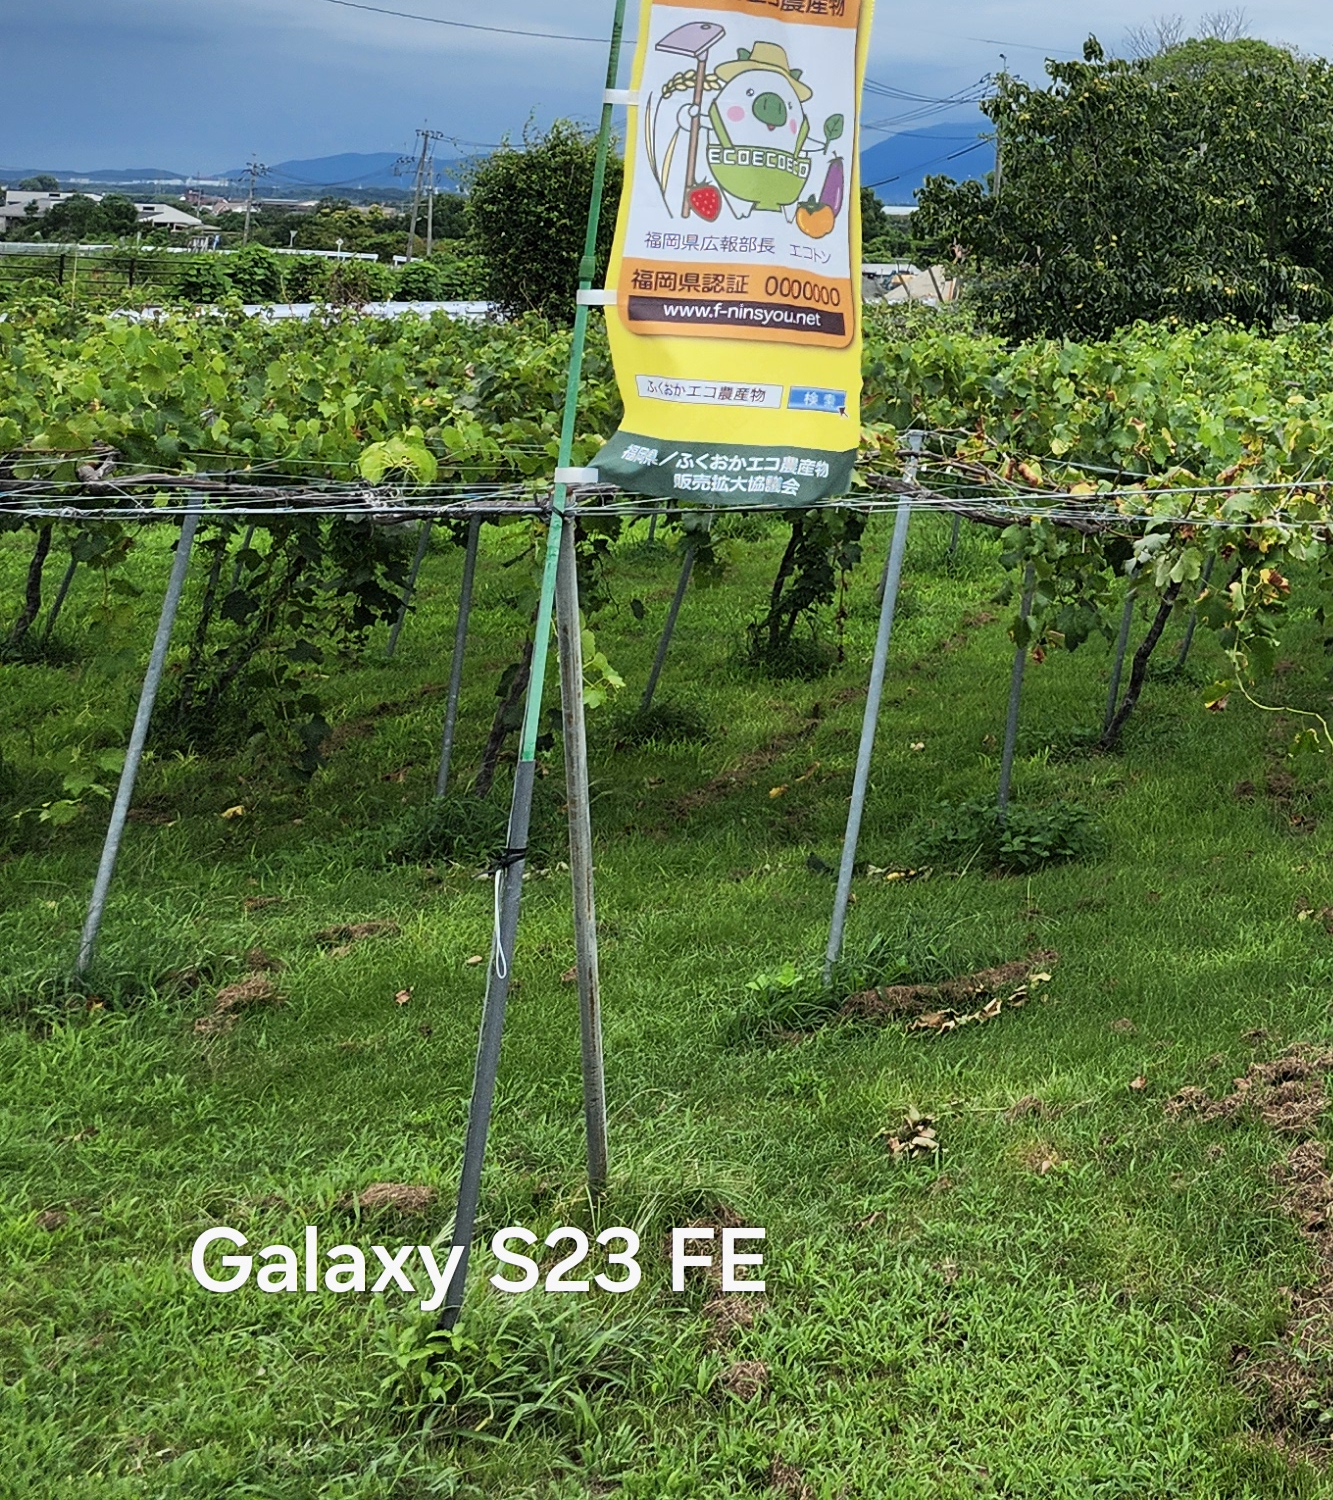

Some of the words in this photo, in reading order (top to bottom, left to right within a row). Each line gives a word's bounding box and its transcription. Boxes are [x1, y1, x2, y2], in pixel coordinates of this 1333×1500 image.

[644, 231, 776, 255] 福岡県広報部長
[630, 269, 750, 294] 福岡県認証
[663, 303, 821, 327] www.f-ninsyou.net
[647, 380, 767, 403] ふくおかエコ農産物
[673, 473, 801, 496] 販売拡大協議会
